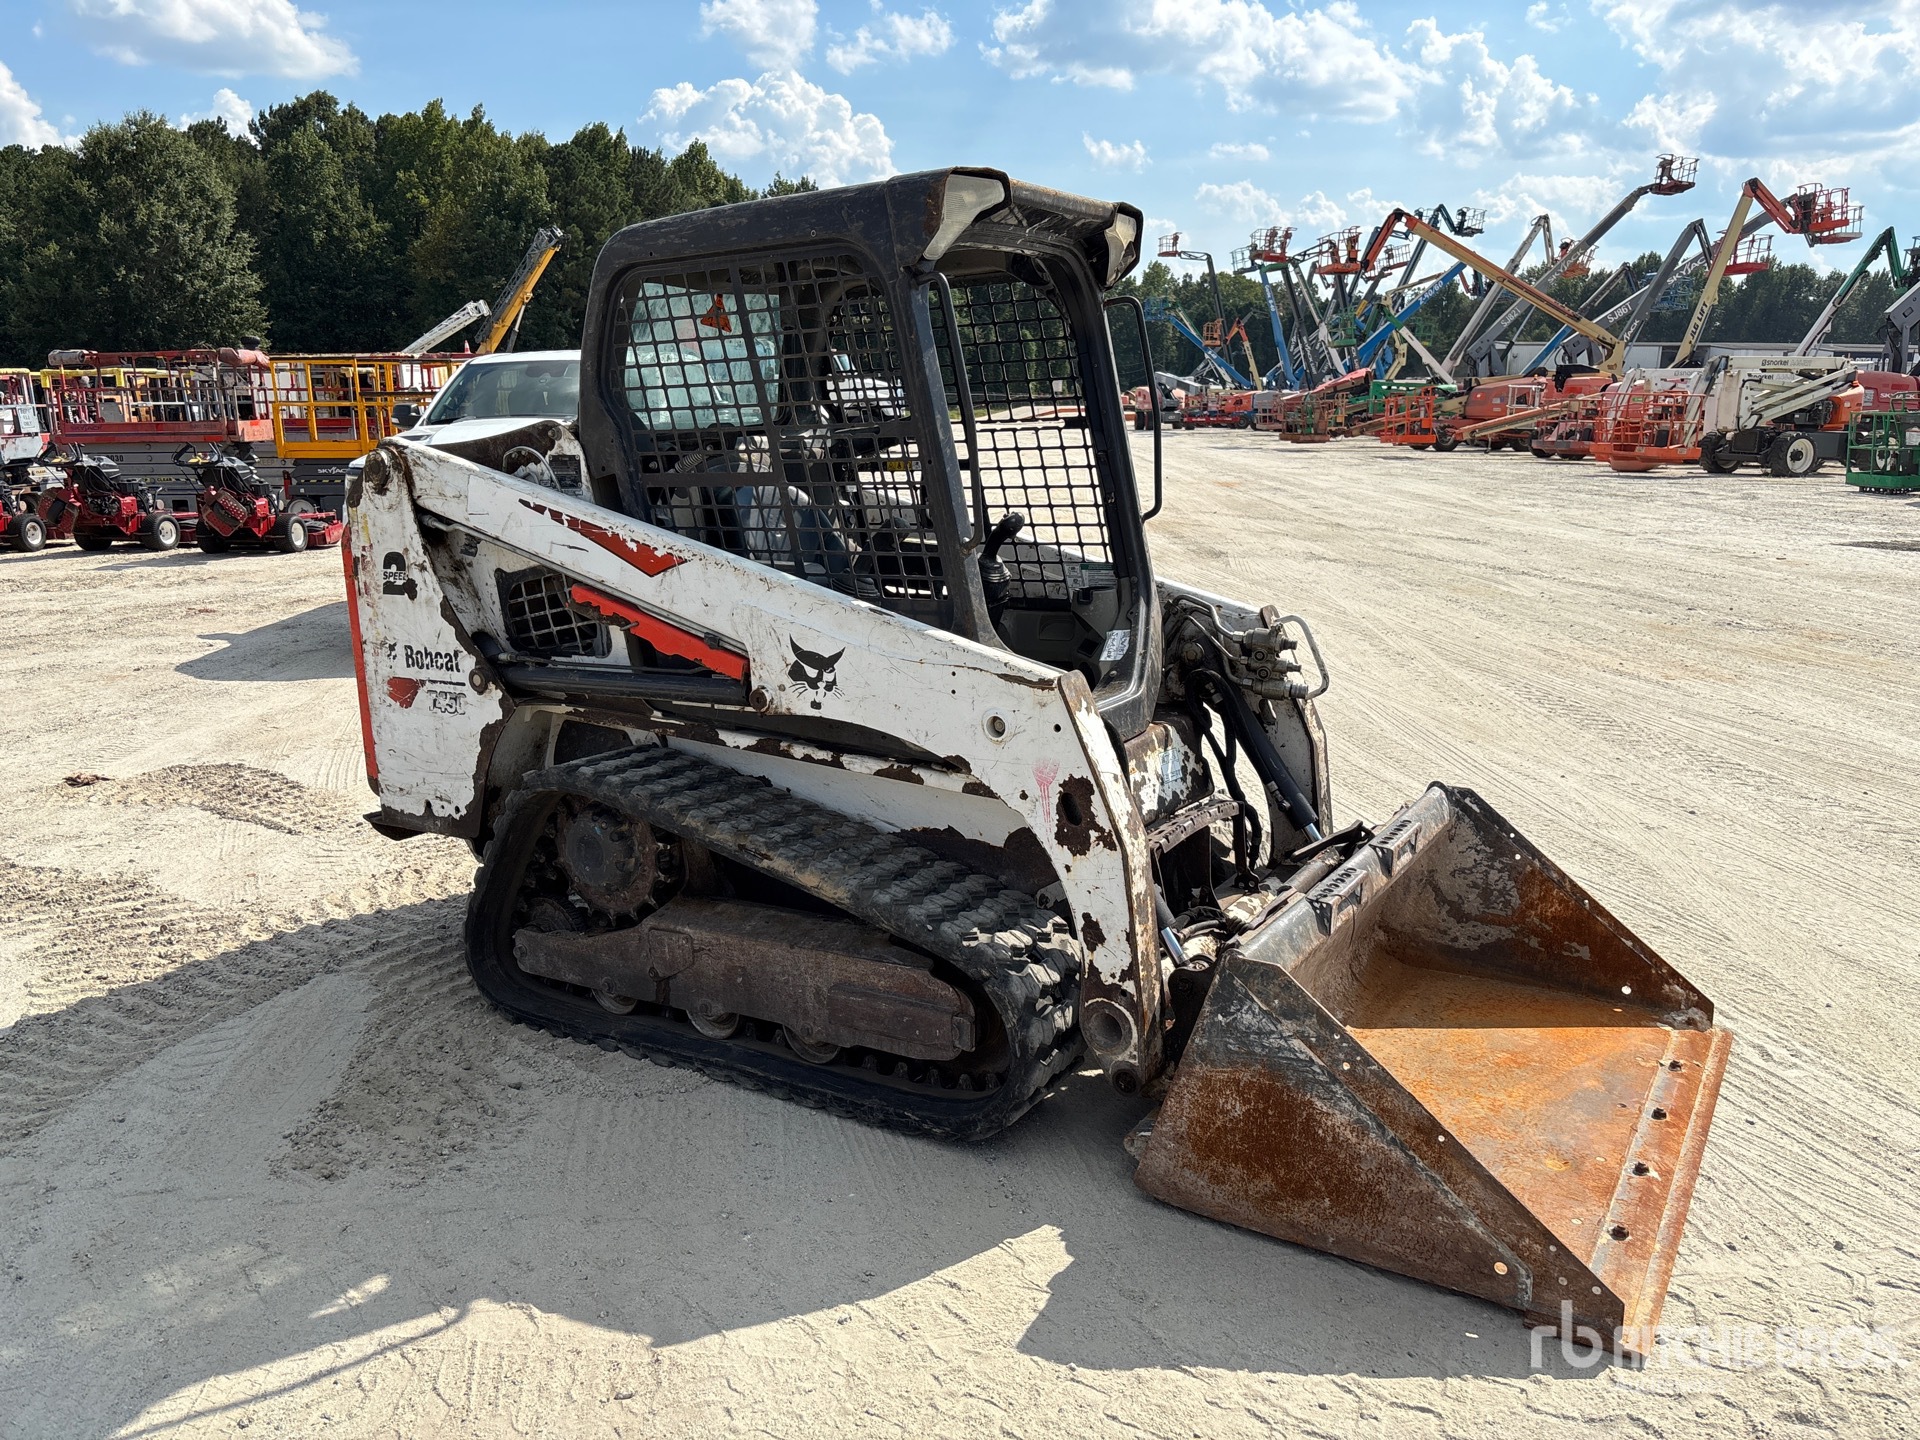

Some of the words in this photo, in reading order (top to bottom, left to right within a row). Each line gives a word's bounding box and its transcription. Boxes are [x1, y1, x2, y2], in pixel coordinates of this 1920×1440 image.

[1547, 248, 1585, 285] SKYJACK
[1607, 302, 1633, 324] SJ86T
[1689, 322, 1700, 340] JLG
[1696, 301, 1708, 323] LIFT
[1766, 358, 1790, 366] snorkel
[317, 466, 347, 474] SKYJAC
[383, 551, 407, 595] 2
[404, 644, 463, 673] Bobcat
